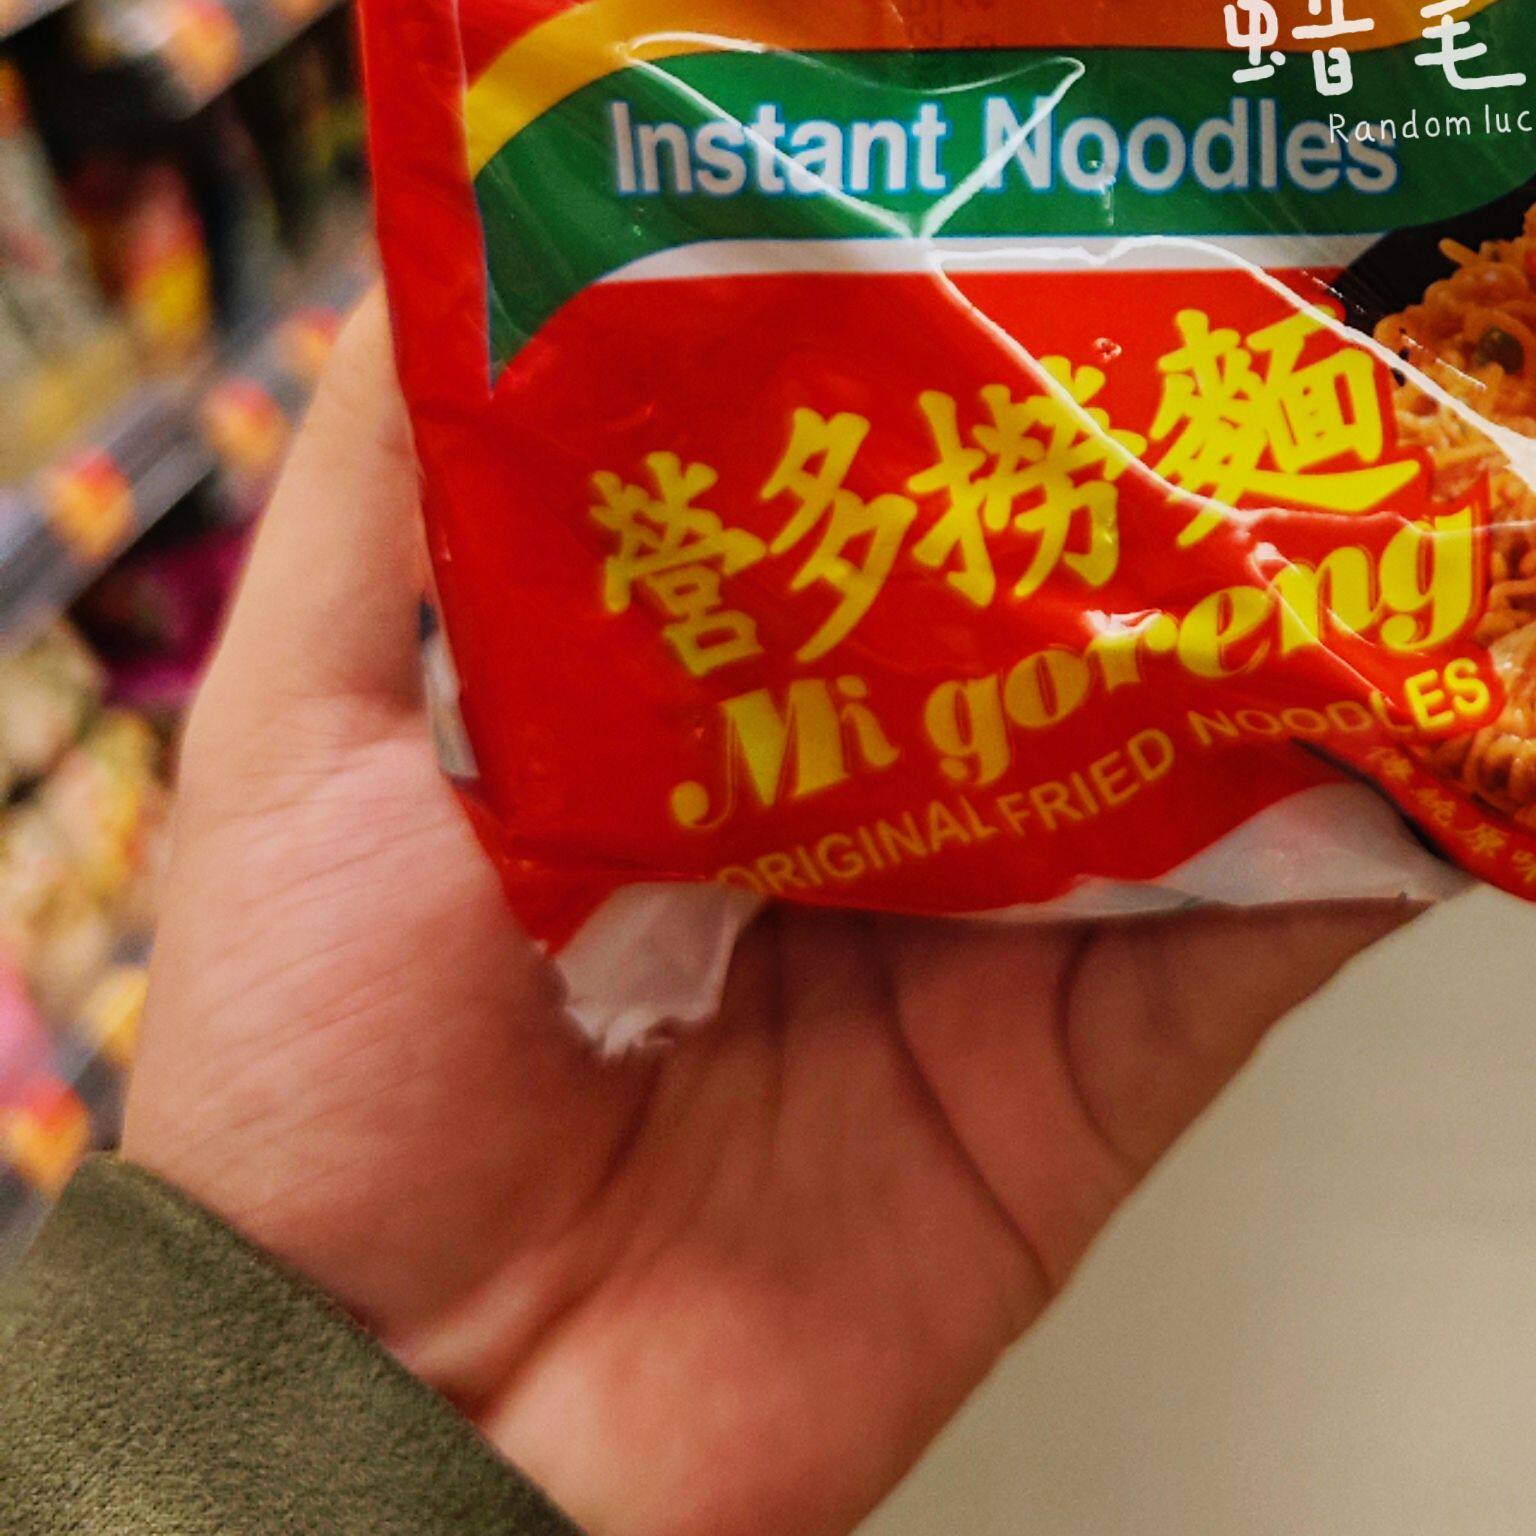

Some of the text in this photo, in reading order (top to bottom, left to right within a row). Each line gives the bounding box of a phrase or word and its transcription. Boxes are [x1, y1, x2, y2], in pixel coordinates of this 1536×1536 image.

[612, 94, 1400, 198] Instant Noodles
[589, 307, 1422, 678] 營多撈麵
[670, 502, 1478, 832] Mi goreng
[998, 728, 1176, 838] FRIED
[1186, 656, 1492, 748] NOODLES
